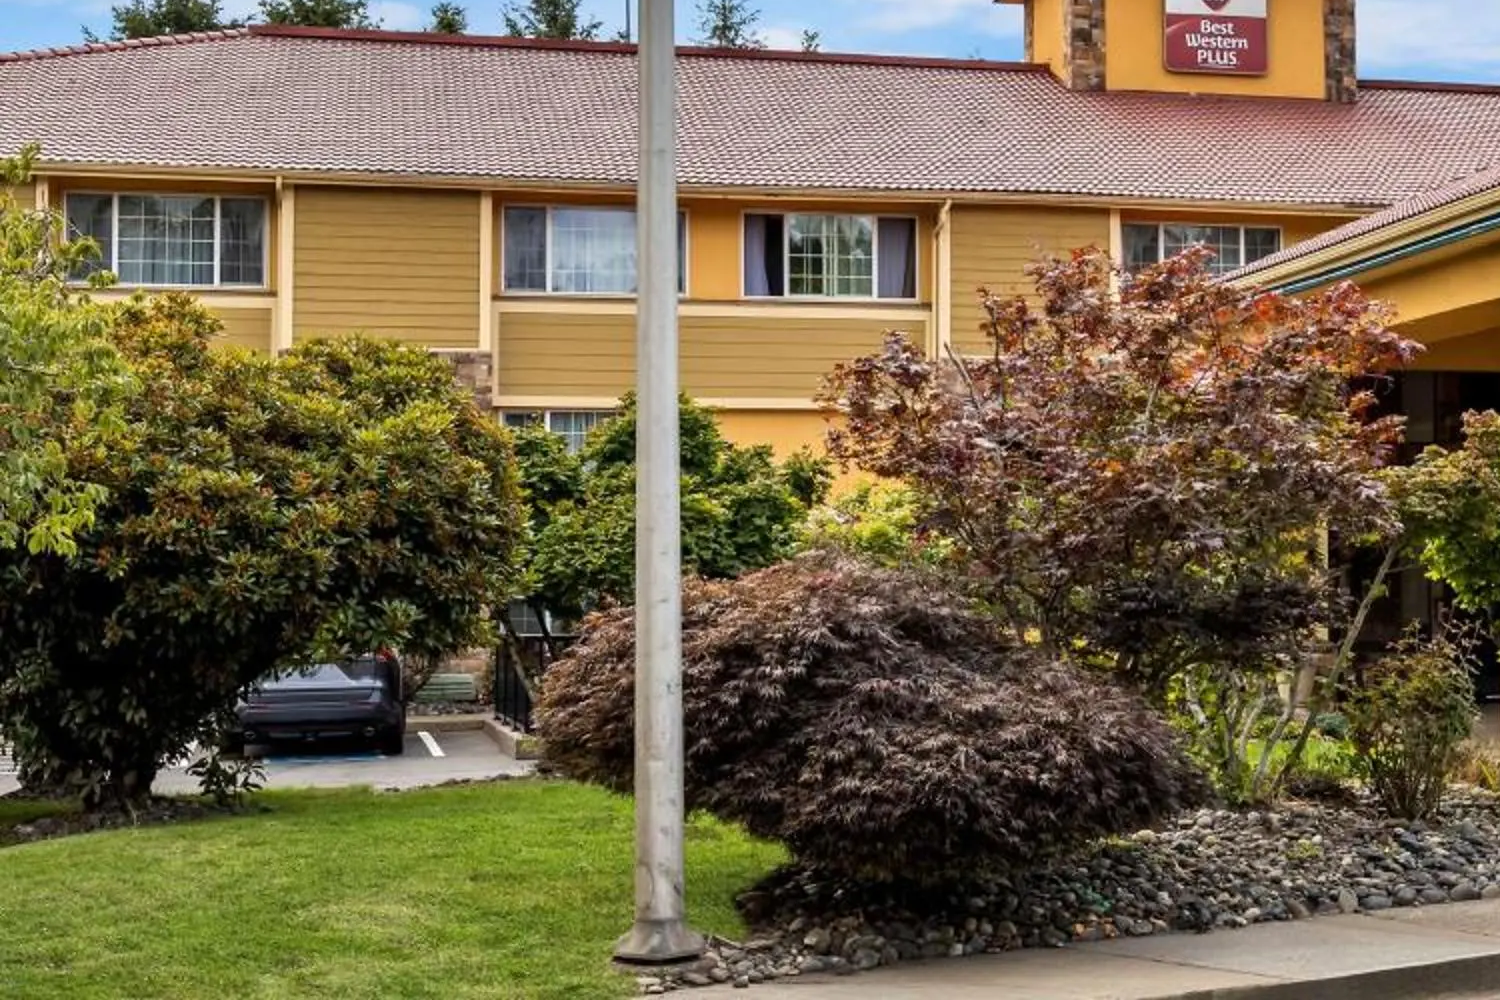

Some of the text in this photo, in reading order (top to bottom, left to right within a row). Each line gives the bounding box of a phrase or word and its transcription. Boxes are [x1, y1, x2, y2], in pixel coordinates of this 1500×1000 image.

[1200, 19, 1235, 35] Best
[1185, 33, 1249, 49] Western
[1197, 49, 1237, 65] PLUS
